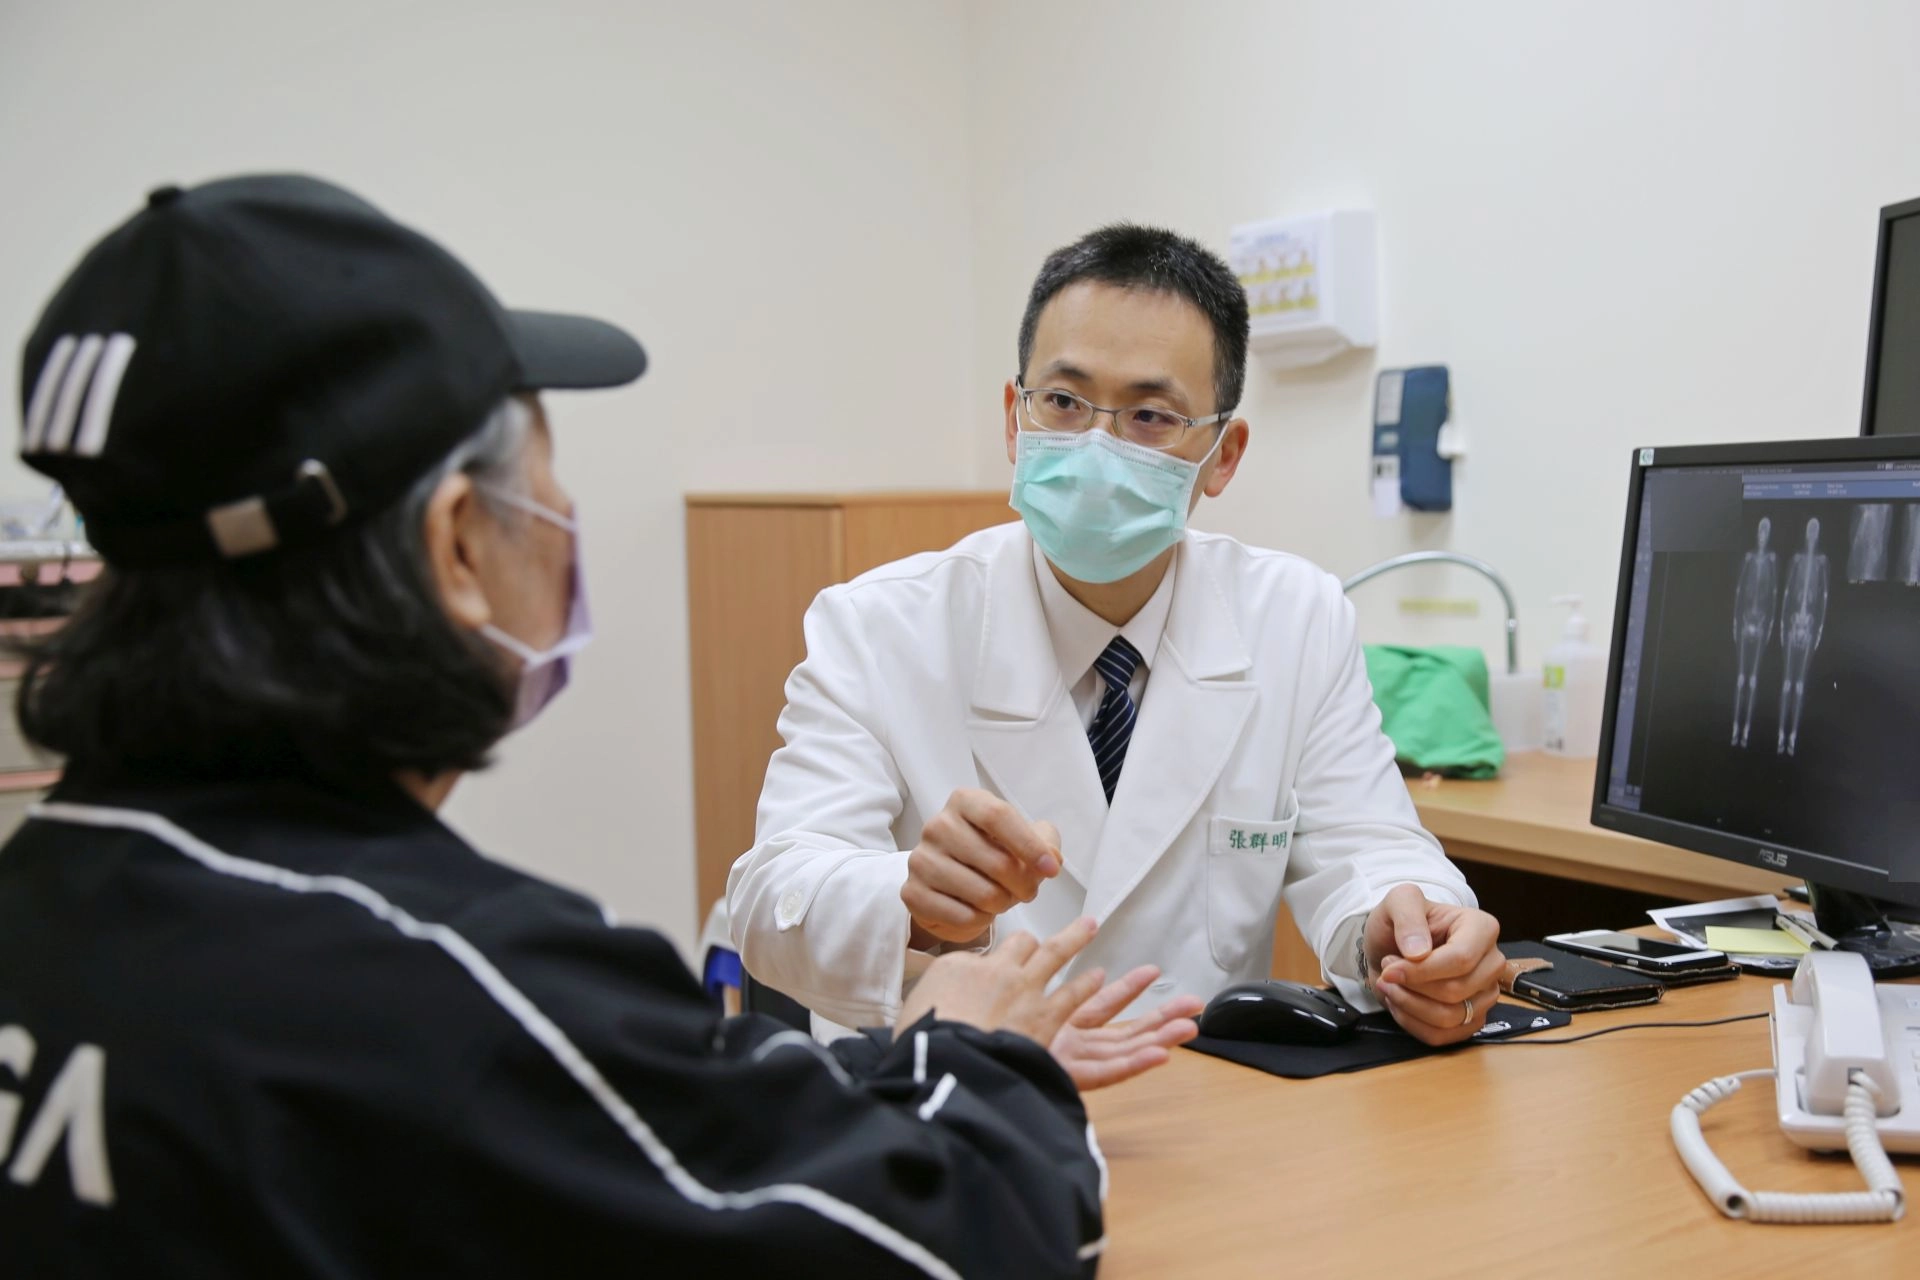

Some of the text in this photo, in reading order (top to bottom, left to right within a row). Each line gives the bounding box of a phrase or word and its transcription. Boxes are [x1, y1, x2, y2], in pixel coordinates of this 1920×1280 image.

[1229, 829, 1288, 853] 張群明
[1757, 848, 1788, 867] ASUS
